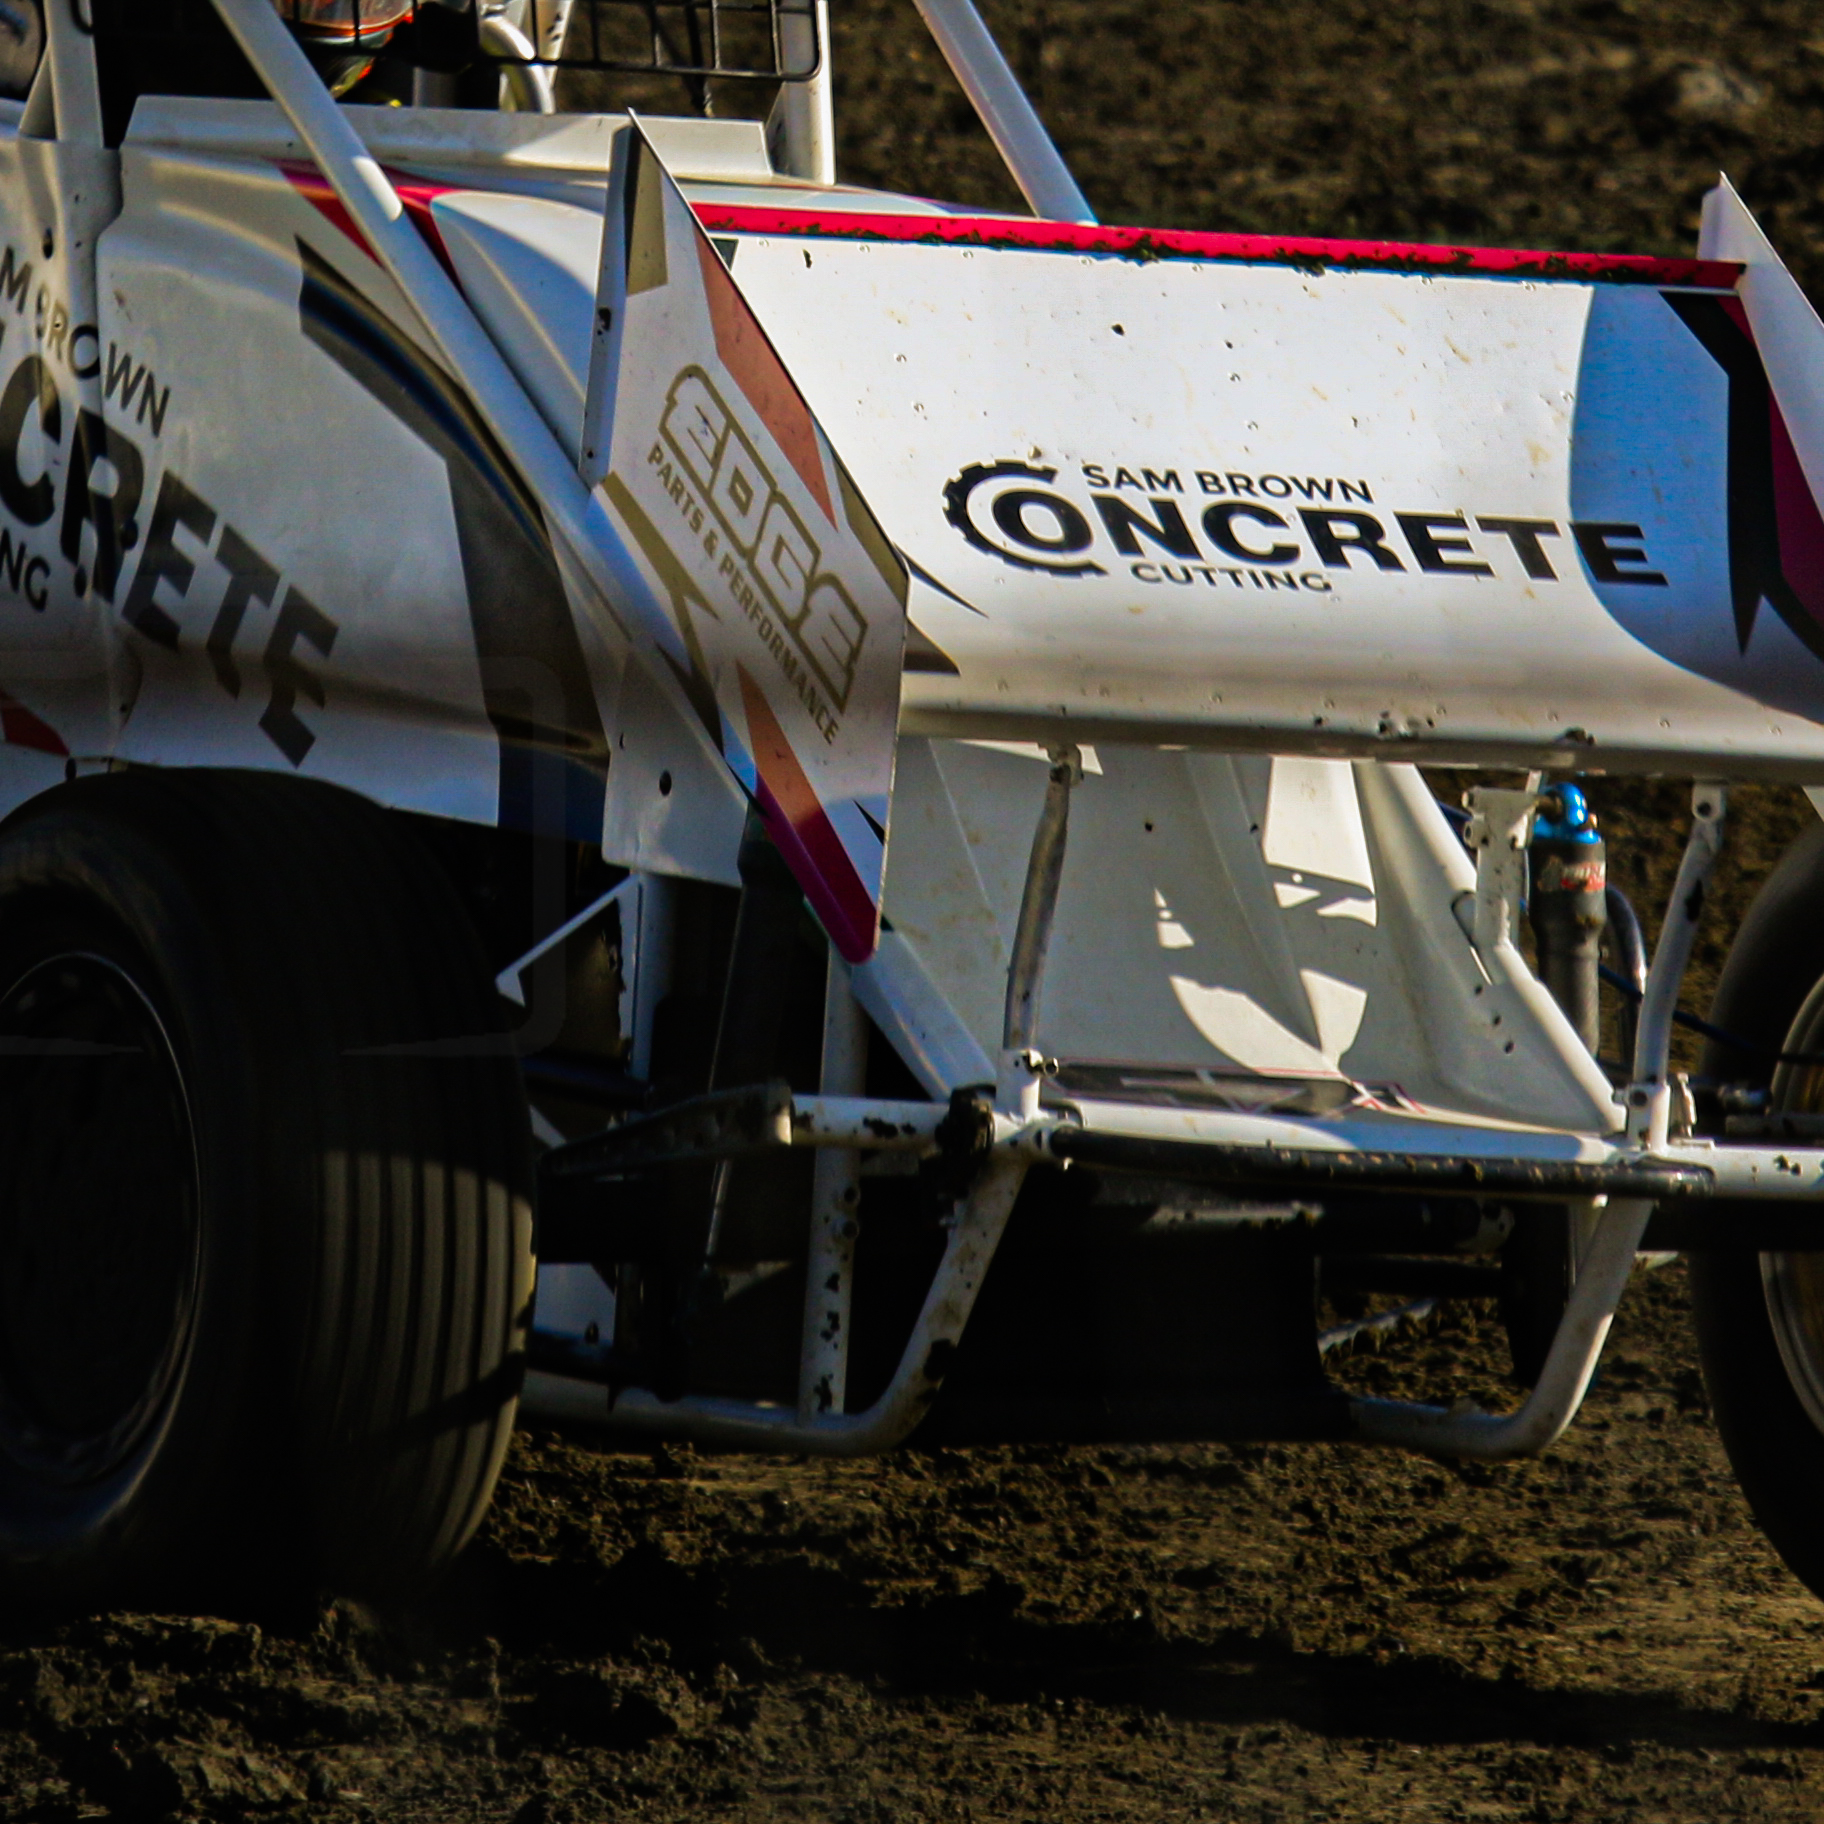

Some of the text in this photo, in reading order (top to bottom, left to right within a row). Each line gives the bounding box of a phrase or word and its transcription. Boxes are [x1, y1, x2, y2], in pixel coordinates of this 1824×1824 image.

[658, 363, 869, 716] EDGE
[940, 458, 1671, 588] CONCRETE
[1080, 464, 1375, 505] SAM BROWN
[647, 442, 841, 746] PARTS & PERFORMANCE
[1128, 562, 1334, 594] CUTTING
